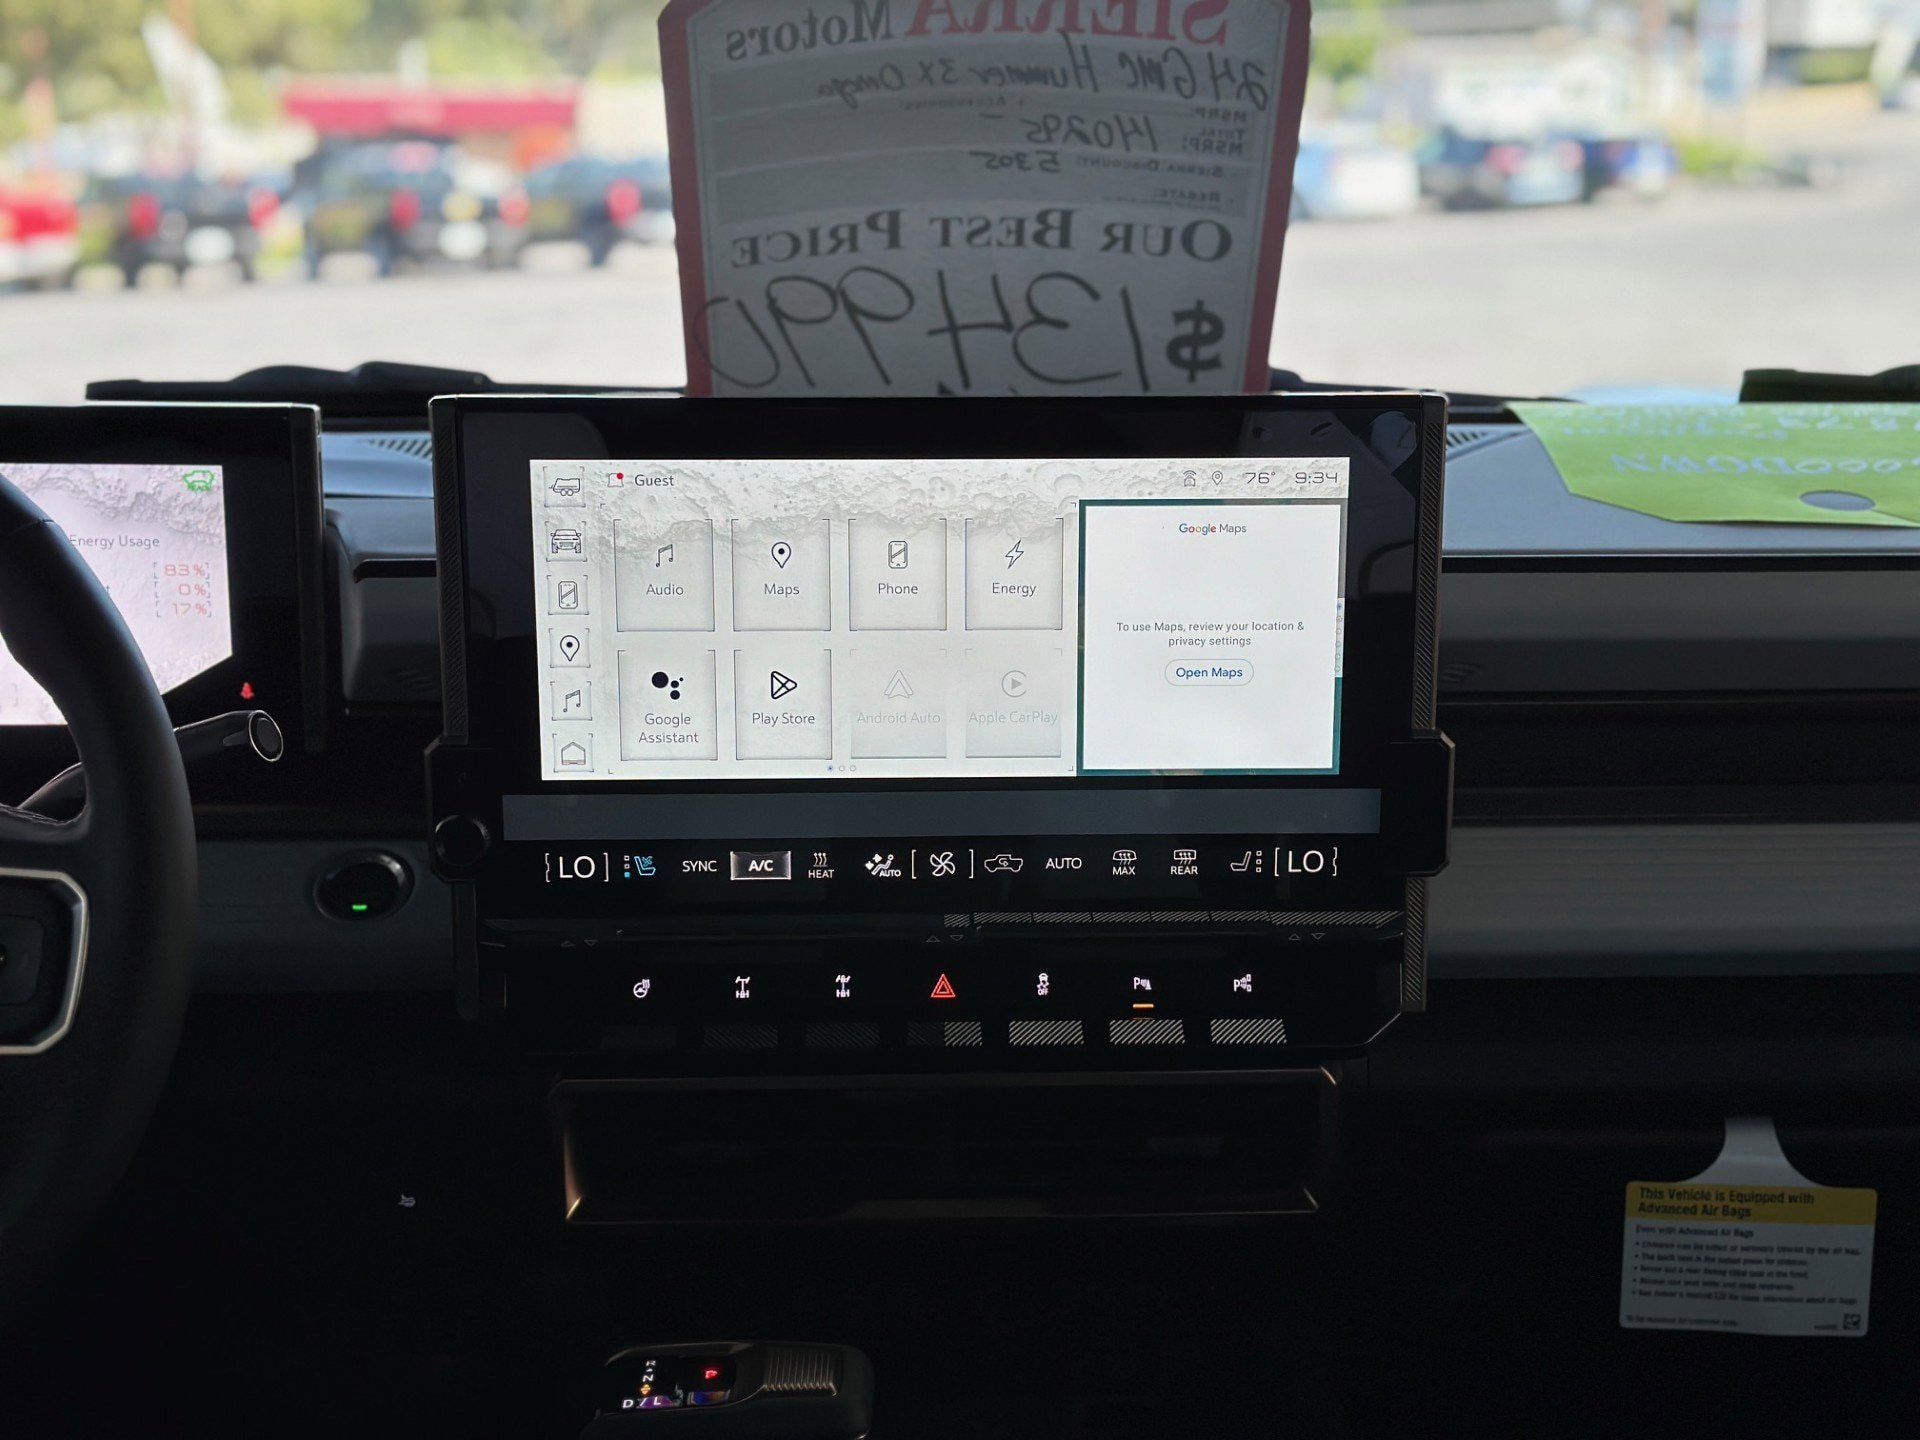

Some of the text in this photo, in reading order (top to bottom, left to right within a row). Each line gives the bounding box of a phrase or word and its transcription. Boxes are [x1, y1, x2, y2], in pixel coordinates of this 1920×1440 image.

[634, 473, 675, 488] Guest
[1294, 471, 1338, 485] 9:34
[1179, 522, 1247, 536] Google Maps
[119, 535, 161, 551] Usage
[646, 583, 684, 596] Audio
[764, 583, 800, 598] Maps
[878, 582, 918, 596] Phone
[992, 582, 1037, 598] Energy
[1116, 620, 1305, 635] To use Maps, review your location &
[1168, 635, 1251, 648] privacy settings
[1176, 666, 1243, 680] Open Maps
[644, 712, 691, 729] Google
[752, 712, 816, 727] Play Store
[856, 711, 941, 724] Android Auto
[968, 710, 1059, 726] Apple CarPlay
[638, 730, 699, 744] Assistant
[558, 856, 596, 880] LO
[682, 859, 717, 873] SYNC
[748, 859, 774, 872] A/C
[1045, 857, 1083, 870] AUTO
[1287, 850, 1324, 874] LO
[807, 869, 835, 880] HEAT
[878, 868, 901, 878] AUTO
[1112, 866, 1136, 876] MAX
[1170, 865, 1199, 876] REAR
[1640, 1186, 1815, 1205] This Vehicle is Equipped with
[1638, 1201, 1752, 1219] Advanced Air Bags
